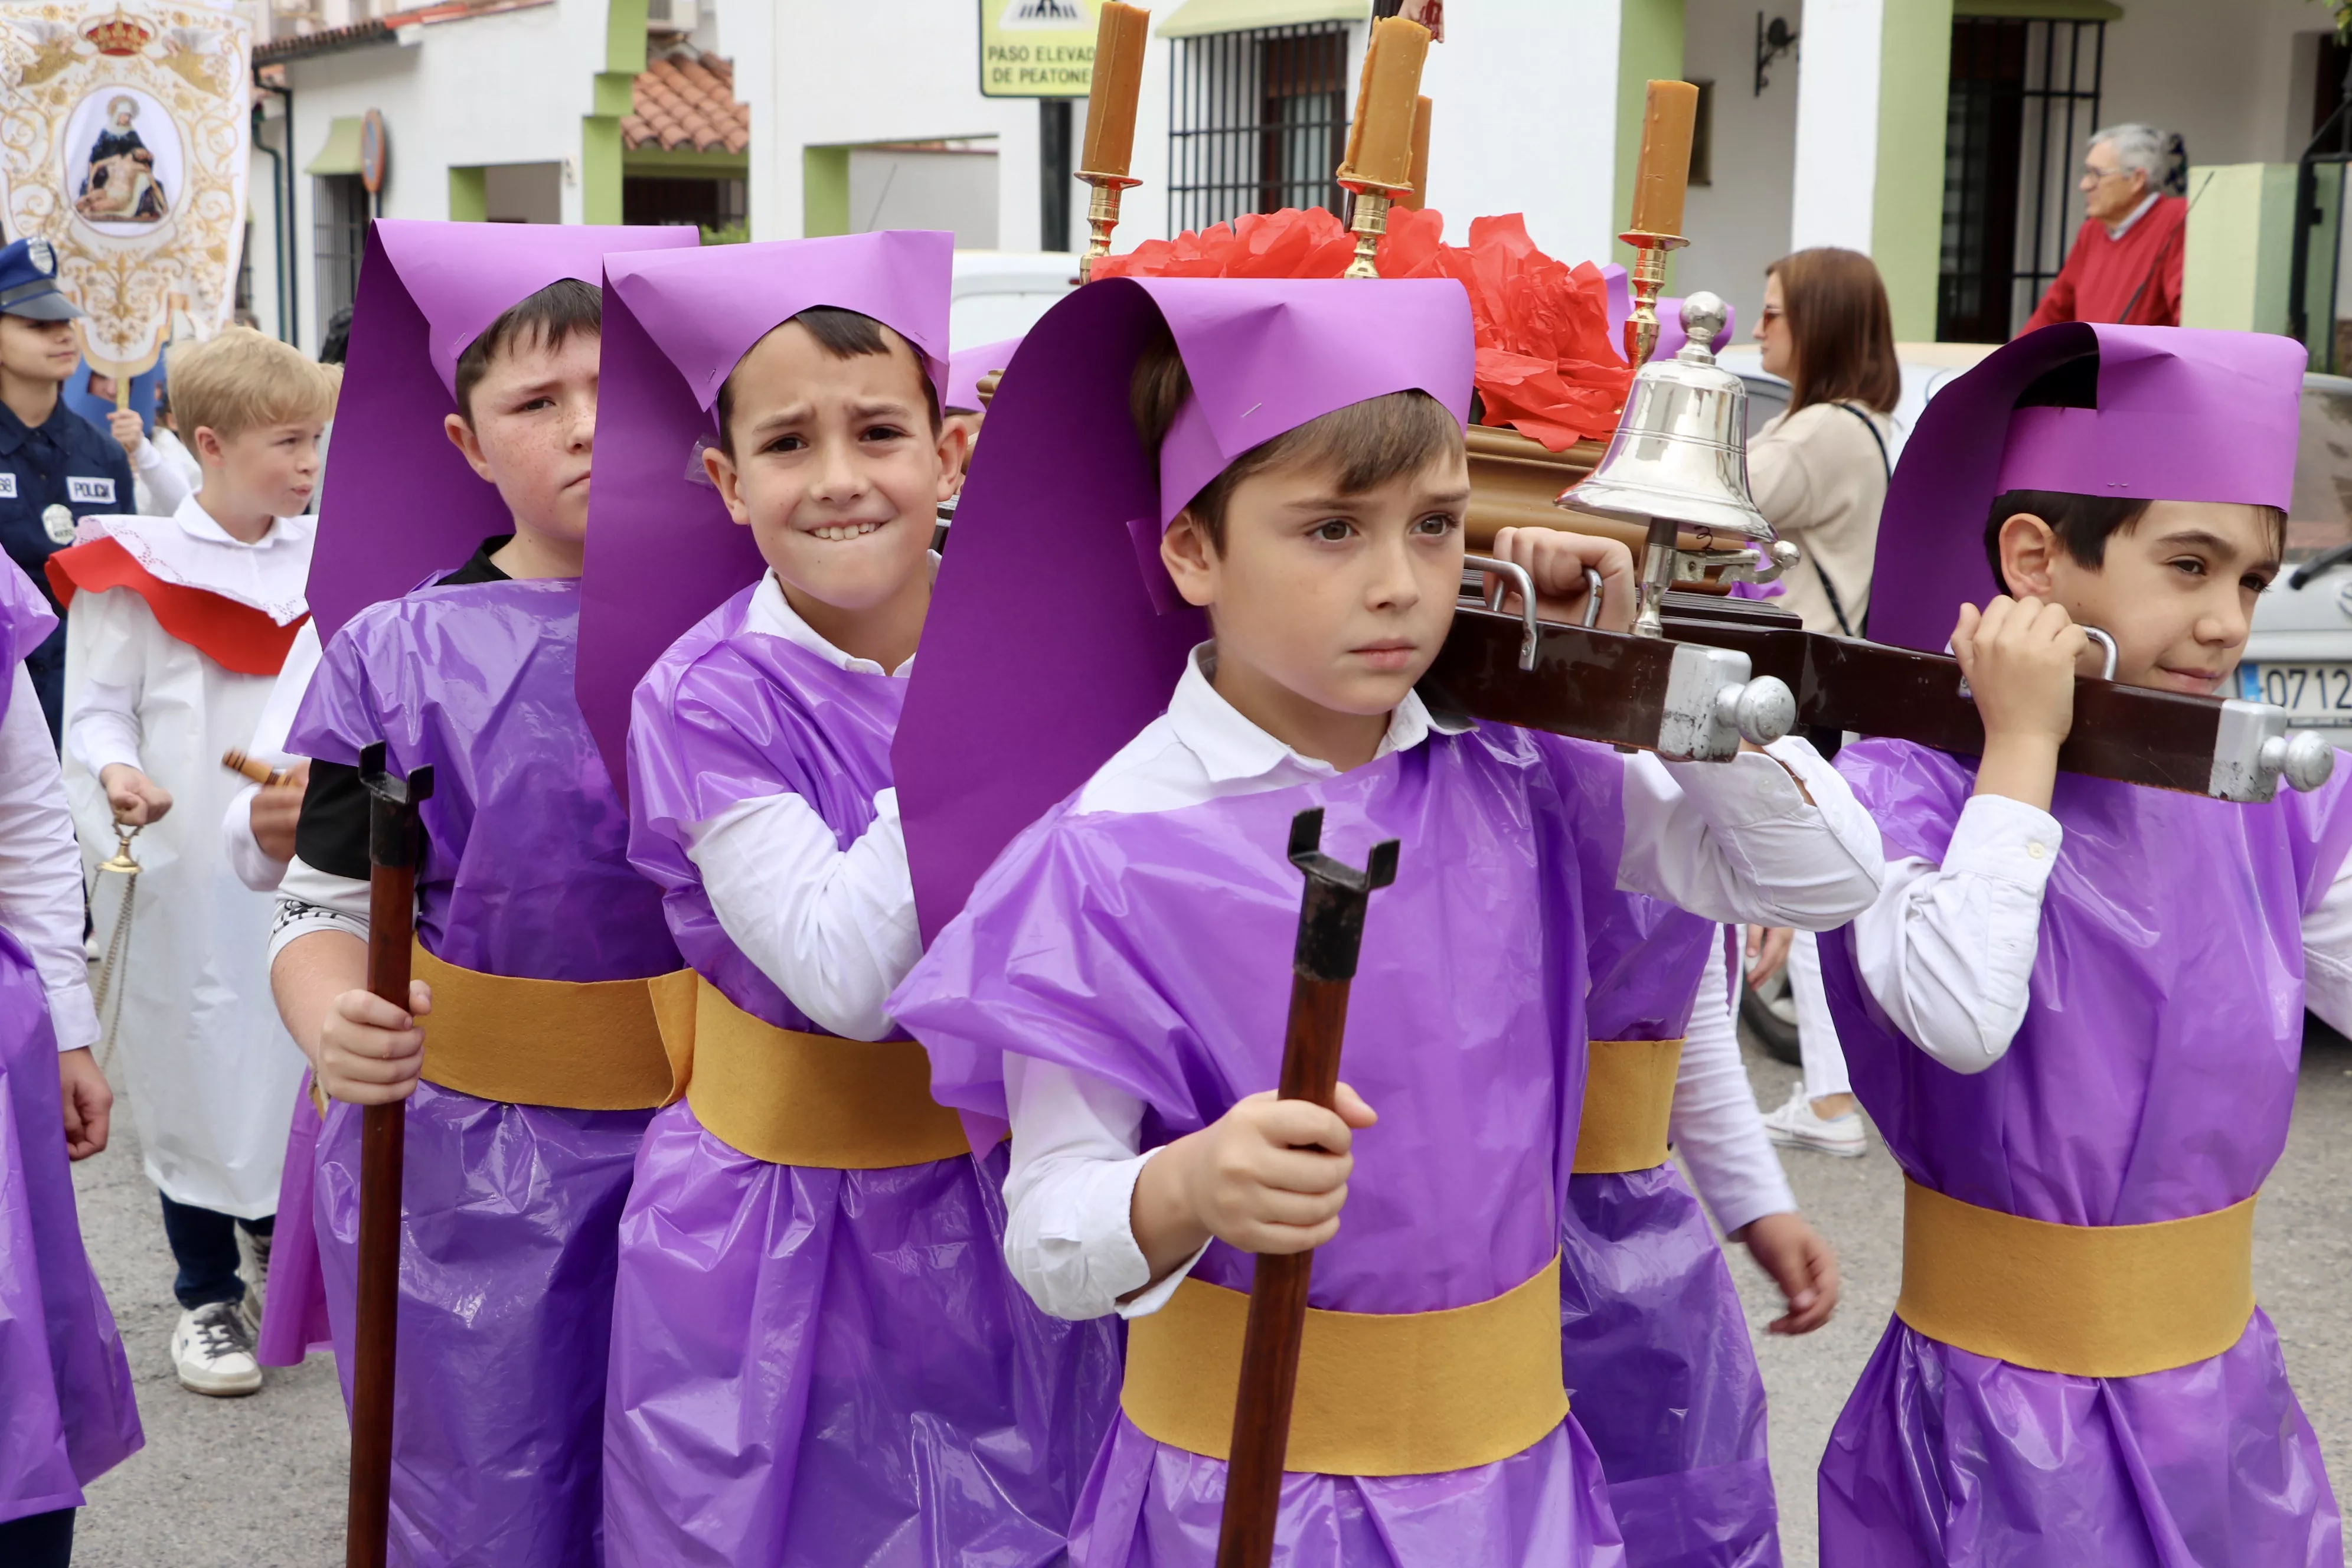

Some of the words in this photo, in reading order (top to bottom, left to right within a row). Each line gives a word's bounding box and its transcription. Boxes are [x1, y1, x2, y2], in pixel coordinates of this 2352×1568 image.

[988, 45, 1029, 61] PASO
[992, 67, 1012, 84] DE
[1019, 67, 1091, 84] PEATONE
[2266, 668, 2352, 710] 0712
